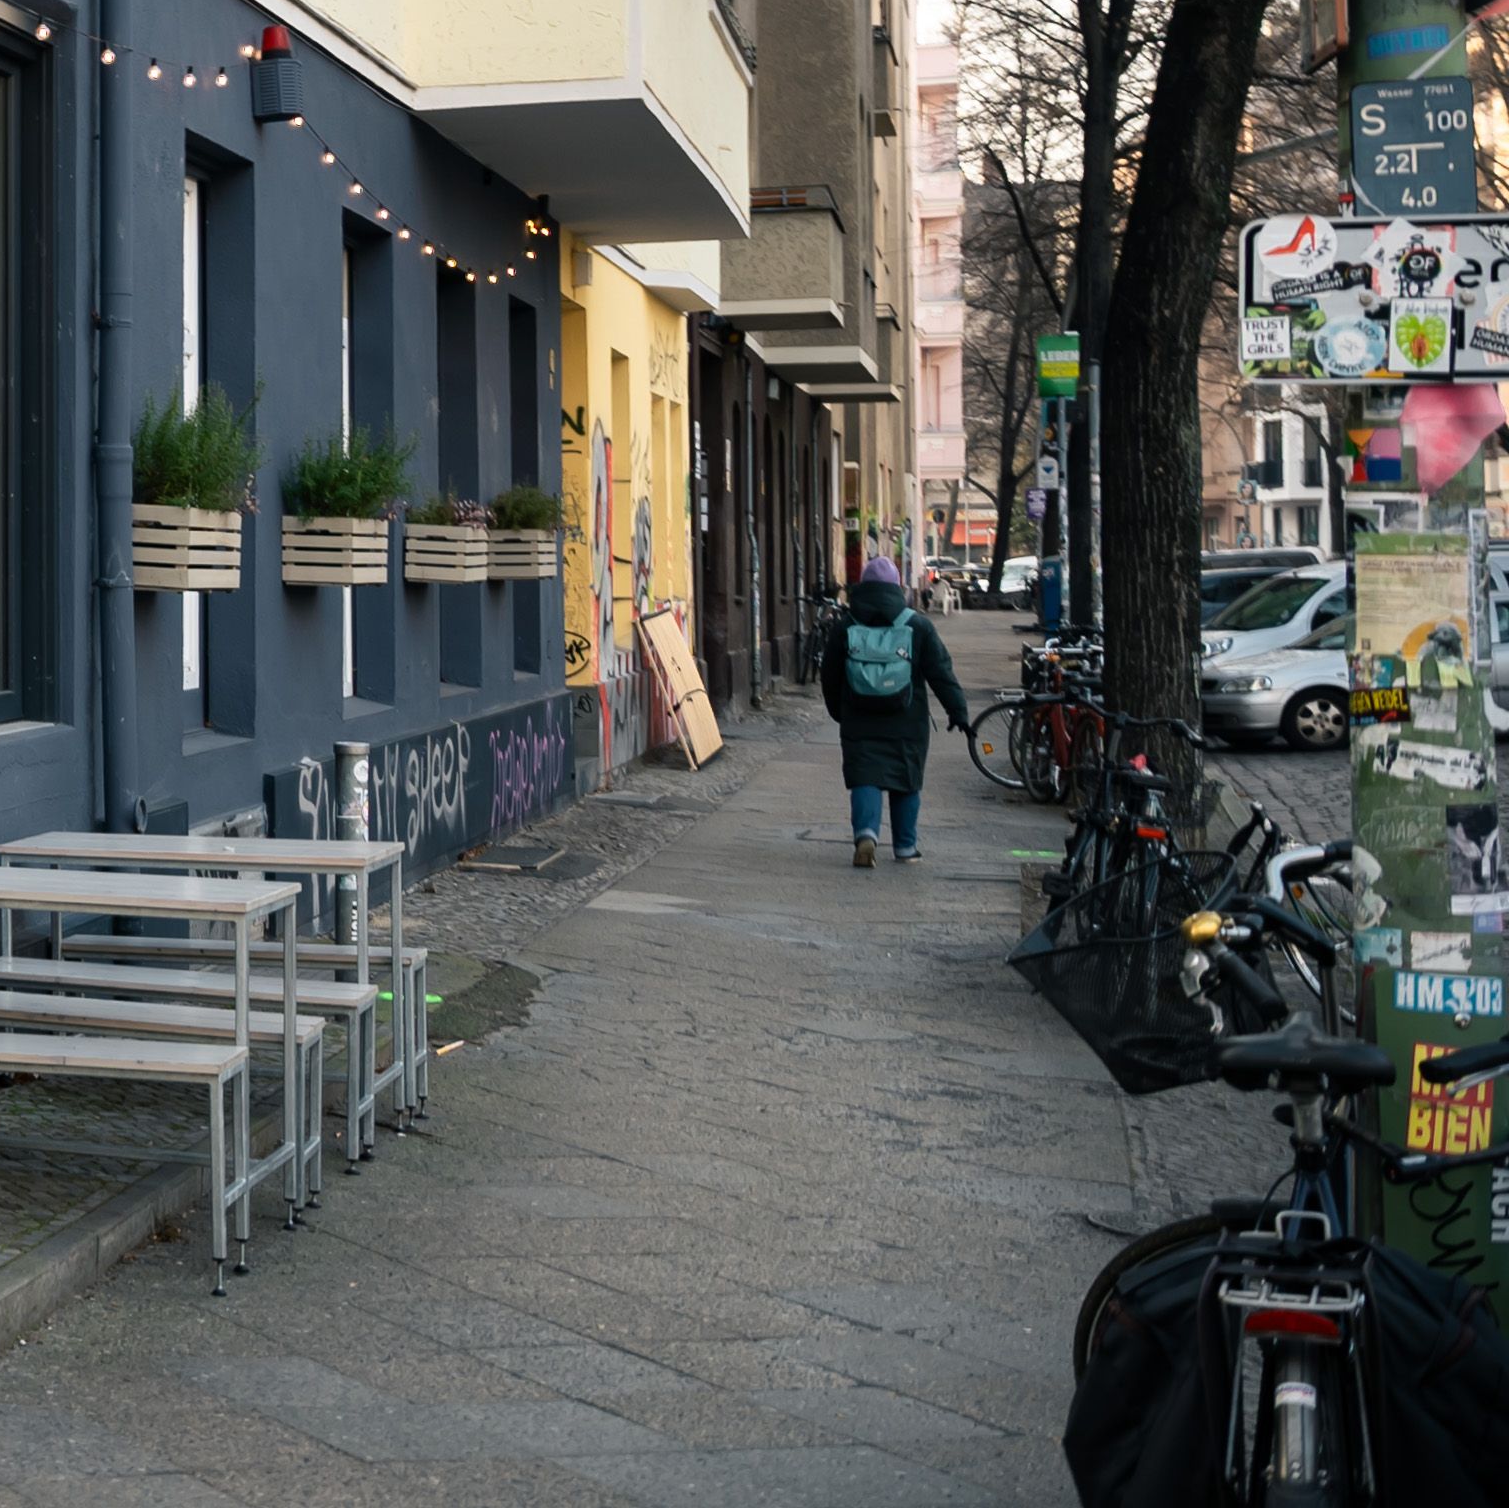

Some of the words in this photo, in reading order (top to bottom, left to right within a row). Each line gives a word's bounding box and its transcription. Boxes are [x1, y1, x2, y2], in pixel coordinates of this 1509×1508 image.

[1377, 87, 1414, 99] Wasser
[1359, 103, 1387, 136] S
[1424, 109, 1468, 133] 100
[1374, 152, 1411, 176] 2.2
[1401, 185, 1438, 209] 4.0
[1274, 283, 1313, 301] HUMAN
[1314, 277, 1344, 292] RIGHT
[1245, 318, 1286, 331] TRUST
[1253, 332, 1278, 343] THE
[1247, 345, 1285, 356] GIRLS
[1407, 1099, 1493, 1154] BIEN
